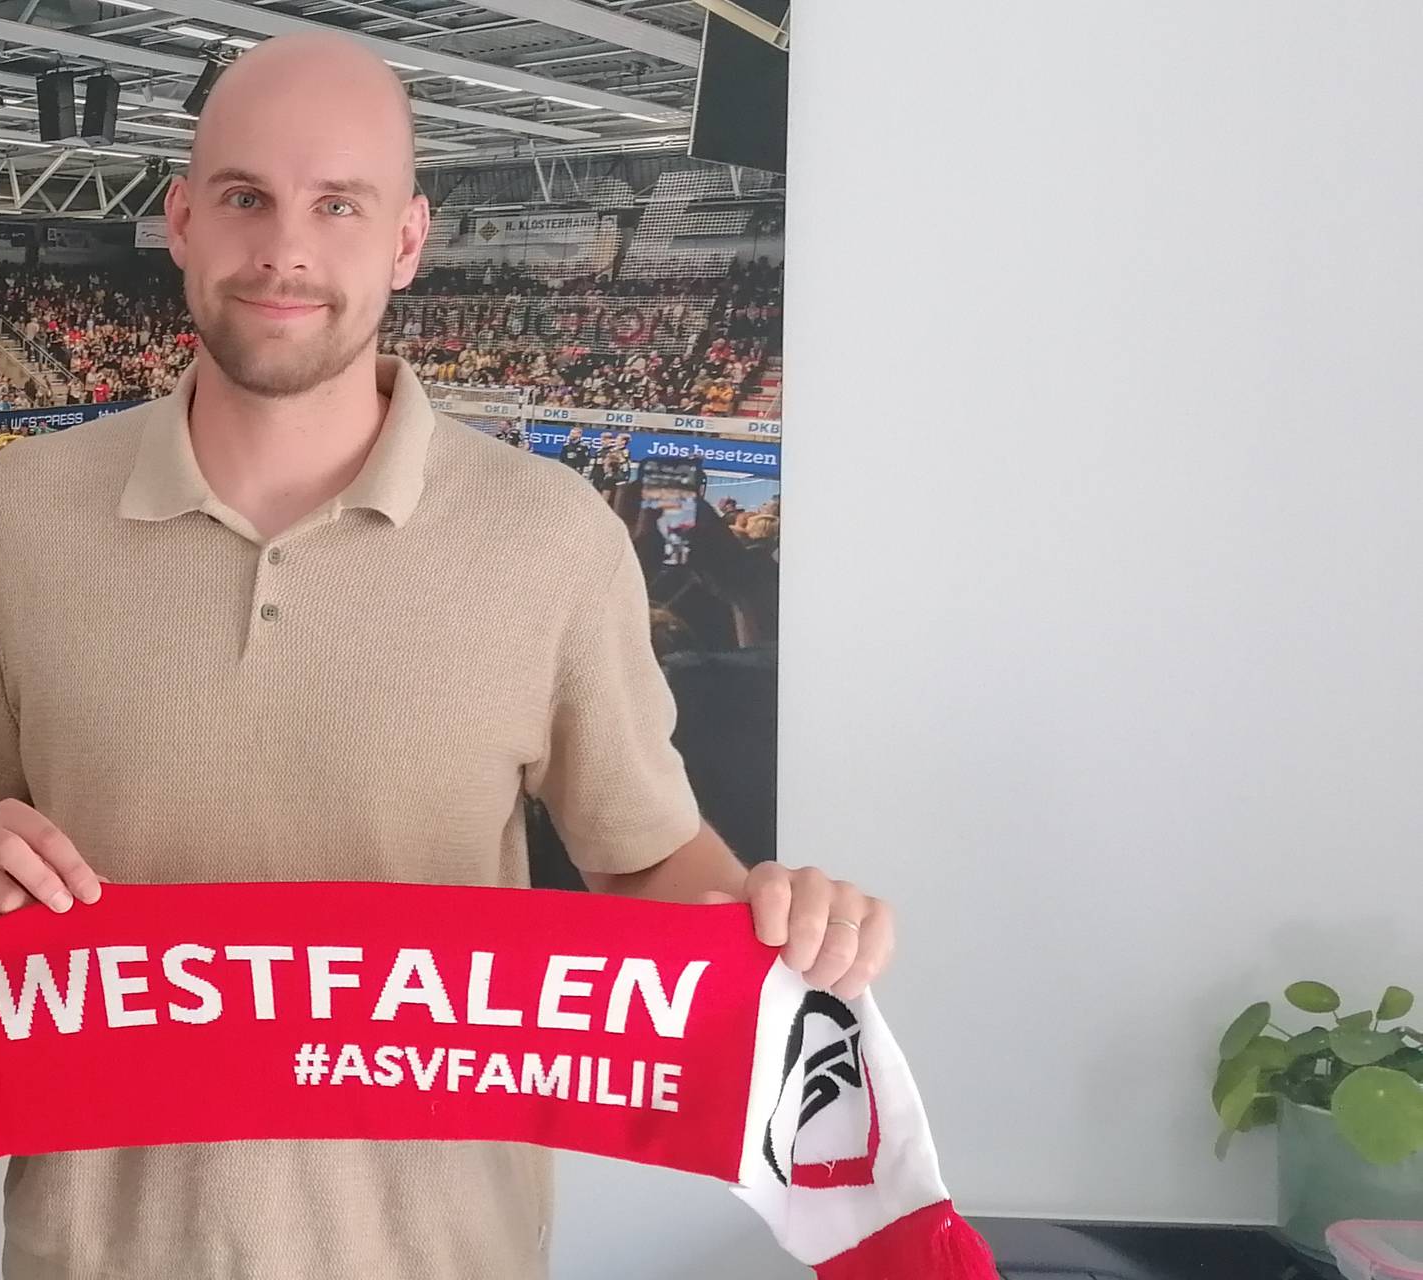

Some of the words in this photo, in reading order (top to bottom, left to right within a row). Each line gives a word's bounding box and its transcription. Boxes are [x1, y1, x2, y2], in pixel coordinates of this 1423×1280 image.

[544, 409, 569, 419] DKB
[606, 413, 633, 423] DKB
[675, 418, 704, 428] DKB
[748, 422, 780, 433] DKB
[647, 442, 689, 457] Jobs
[693, 445, 777, 465] besetzen
[294, 1043, 682, 1112] #ASVFAMILIE
